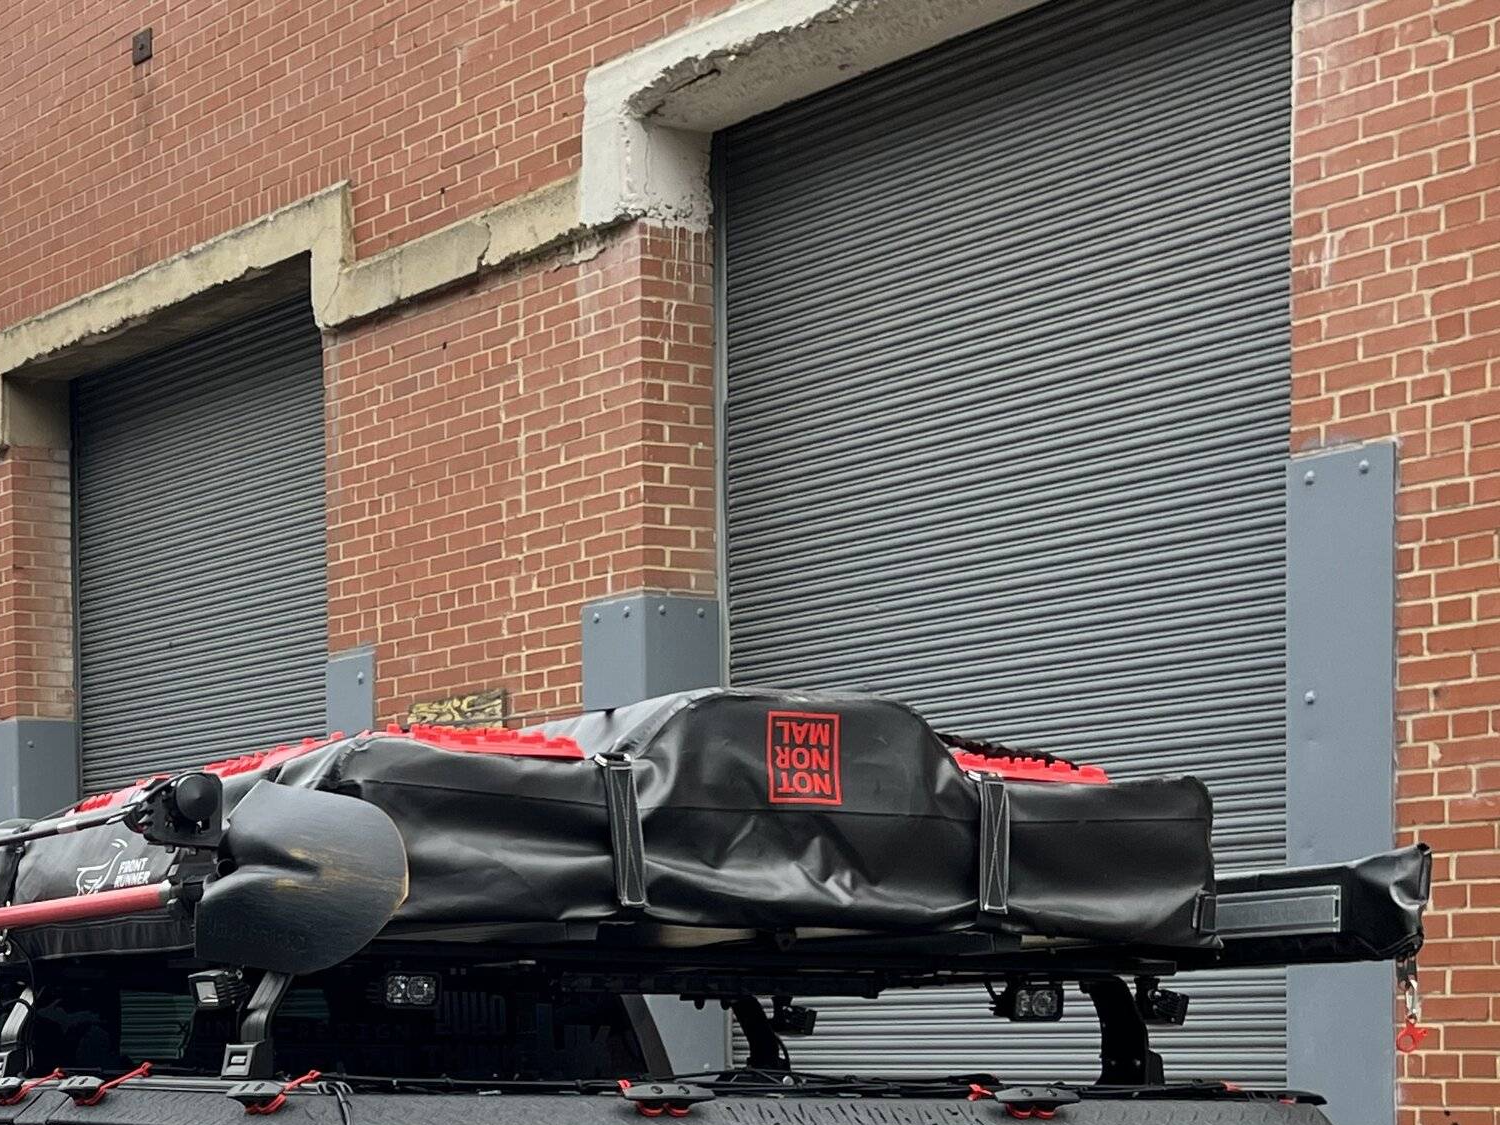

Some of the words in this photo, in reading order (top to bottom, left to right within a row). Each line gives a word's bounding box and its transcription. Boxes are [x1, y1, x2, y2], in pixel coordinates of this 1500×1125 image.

[775, 721, 830, 746] MAL
[774, 746, 830, 769] NOR
[777, 771, 832, 795] NOT
[118, 857, 149, 875] FRONT
[113, 870, 151, 888] RUNNER
